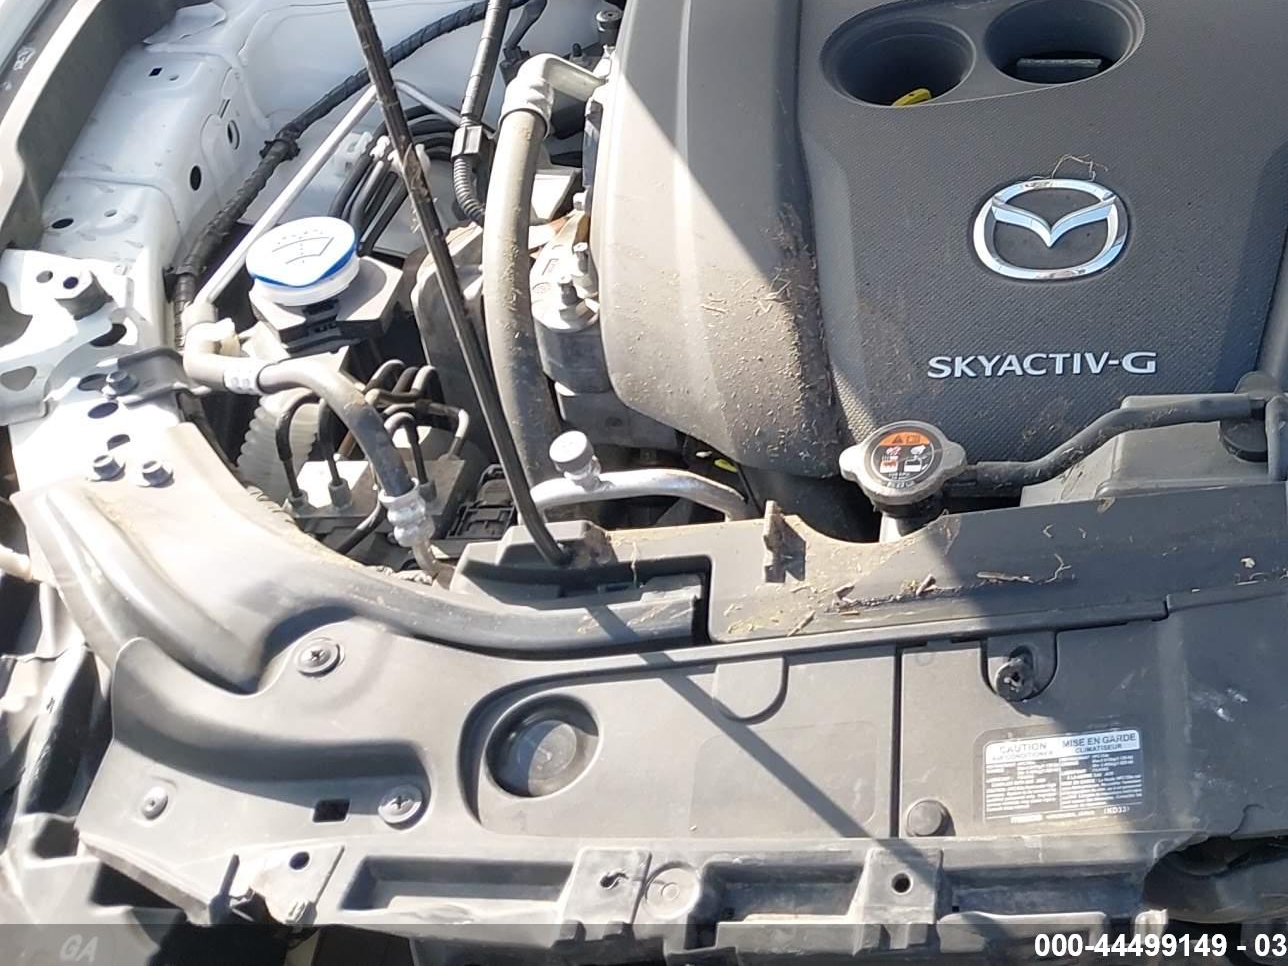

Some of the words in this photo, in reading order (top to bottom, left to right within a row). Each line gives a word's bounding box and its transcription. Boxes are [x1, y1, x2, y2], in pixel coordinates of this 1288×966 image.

[926, 351, 1157, 378] SKYACTIV-G
[1062, 738, 1086, 747] MISE
[1088, 737, 1101, 745] EN
[1102, 734, 1136, 744] GARDE
[1000, 743, 1047, 754] CAUTION
[1075, 744, 1122, 753] CLIMATISEUR
